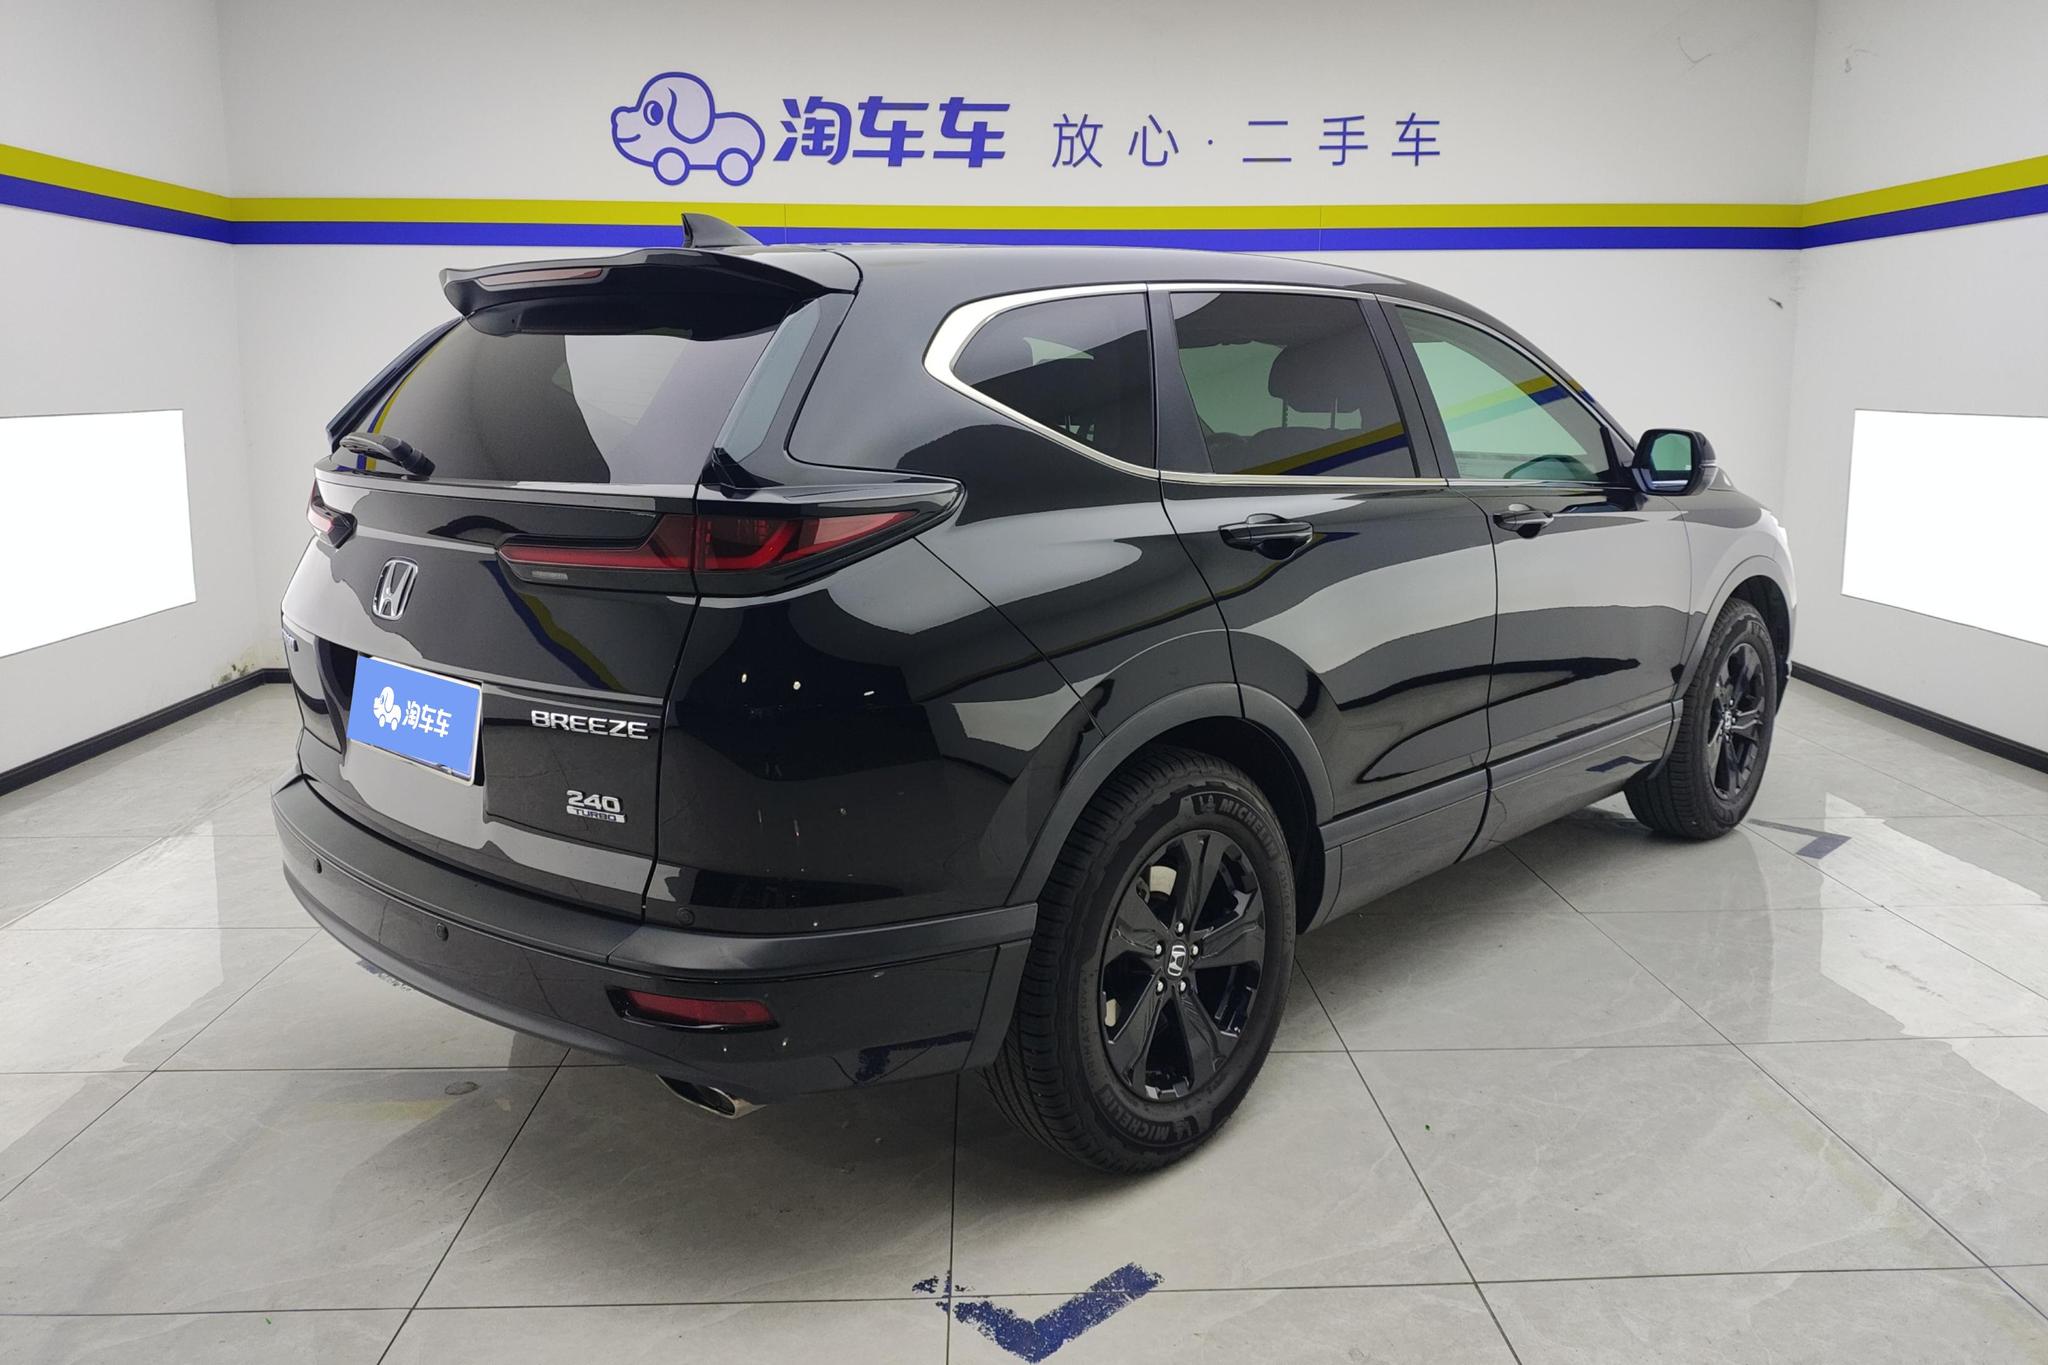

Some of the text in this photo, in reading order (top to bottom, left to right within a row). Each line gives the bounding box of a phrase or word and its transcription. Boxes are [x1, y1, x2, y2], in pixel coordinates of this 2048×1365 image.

[773, 96, 1010, 168] 淘车车
[530, 709, 649, 740] BREEZE
[566, 790, 621, 813] 240
[1218, 797, 1280, 861] MICHELIN
[1101, 1084, 1170, 1141] MICHELIN
